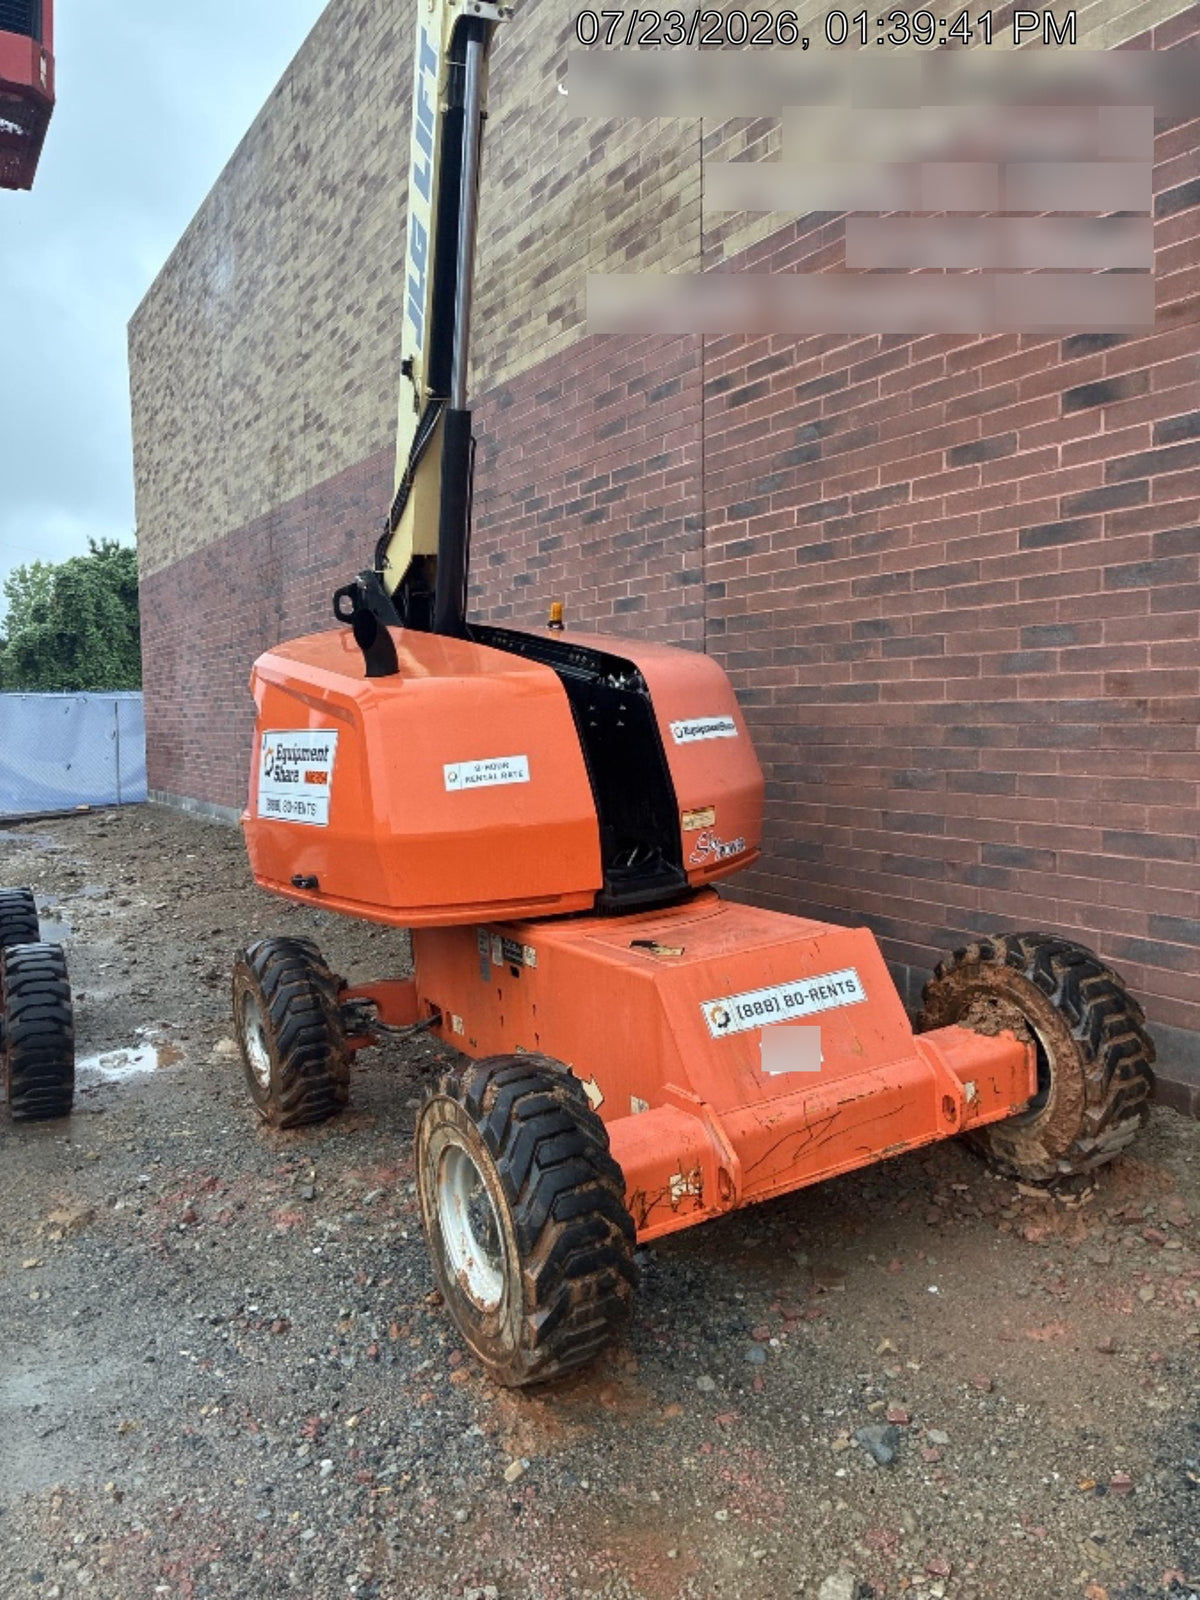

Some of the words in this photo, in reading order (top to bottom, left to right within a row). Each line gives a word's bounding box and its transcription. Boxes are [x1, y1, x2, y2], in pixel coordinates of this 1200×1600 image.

[413, 25, 438, 204] LIFT
[407, 211, 428, 352] JLG
[276, 743, 329, 765] Equipment
[273, 765, 299, 783] Share
[736, 997, 780, 1020] (888)
